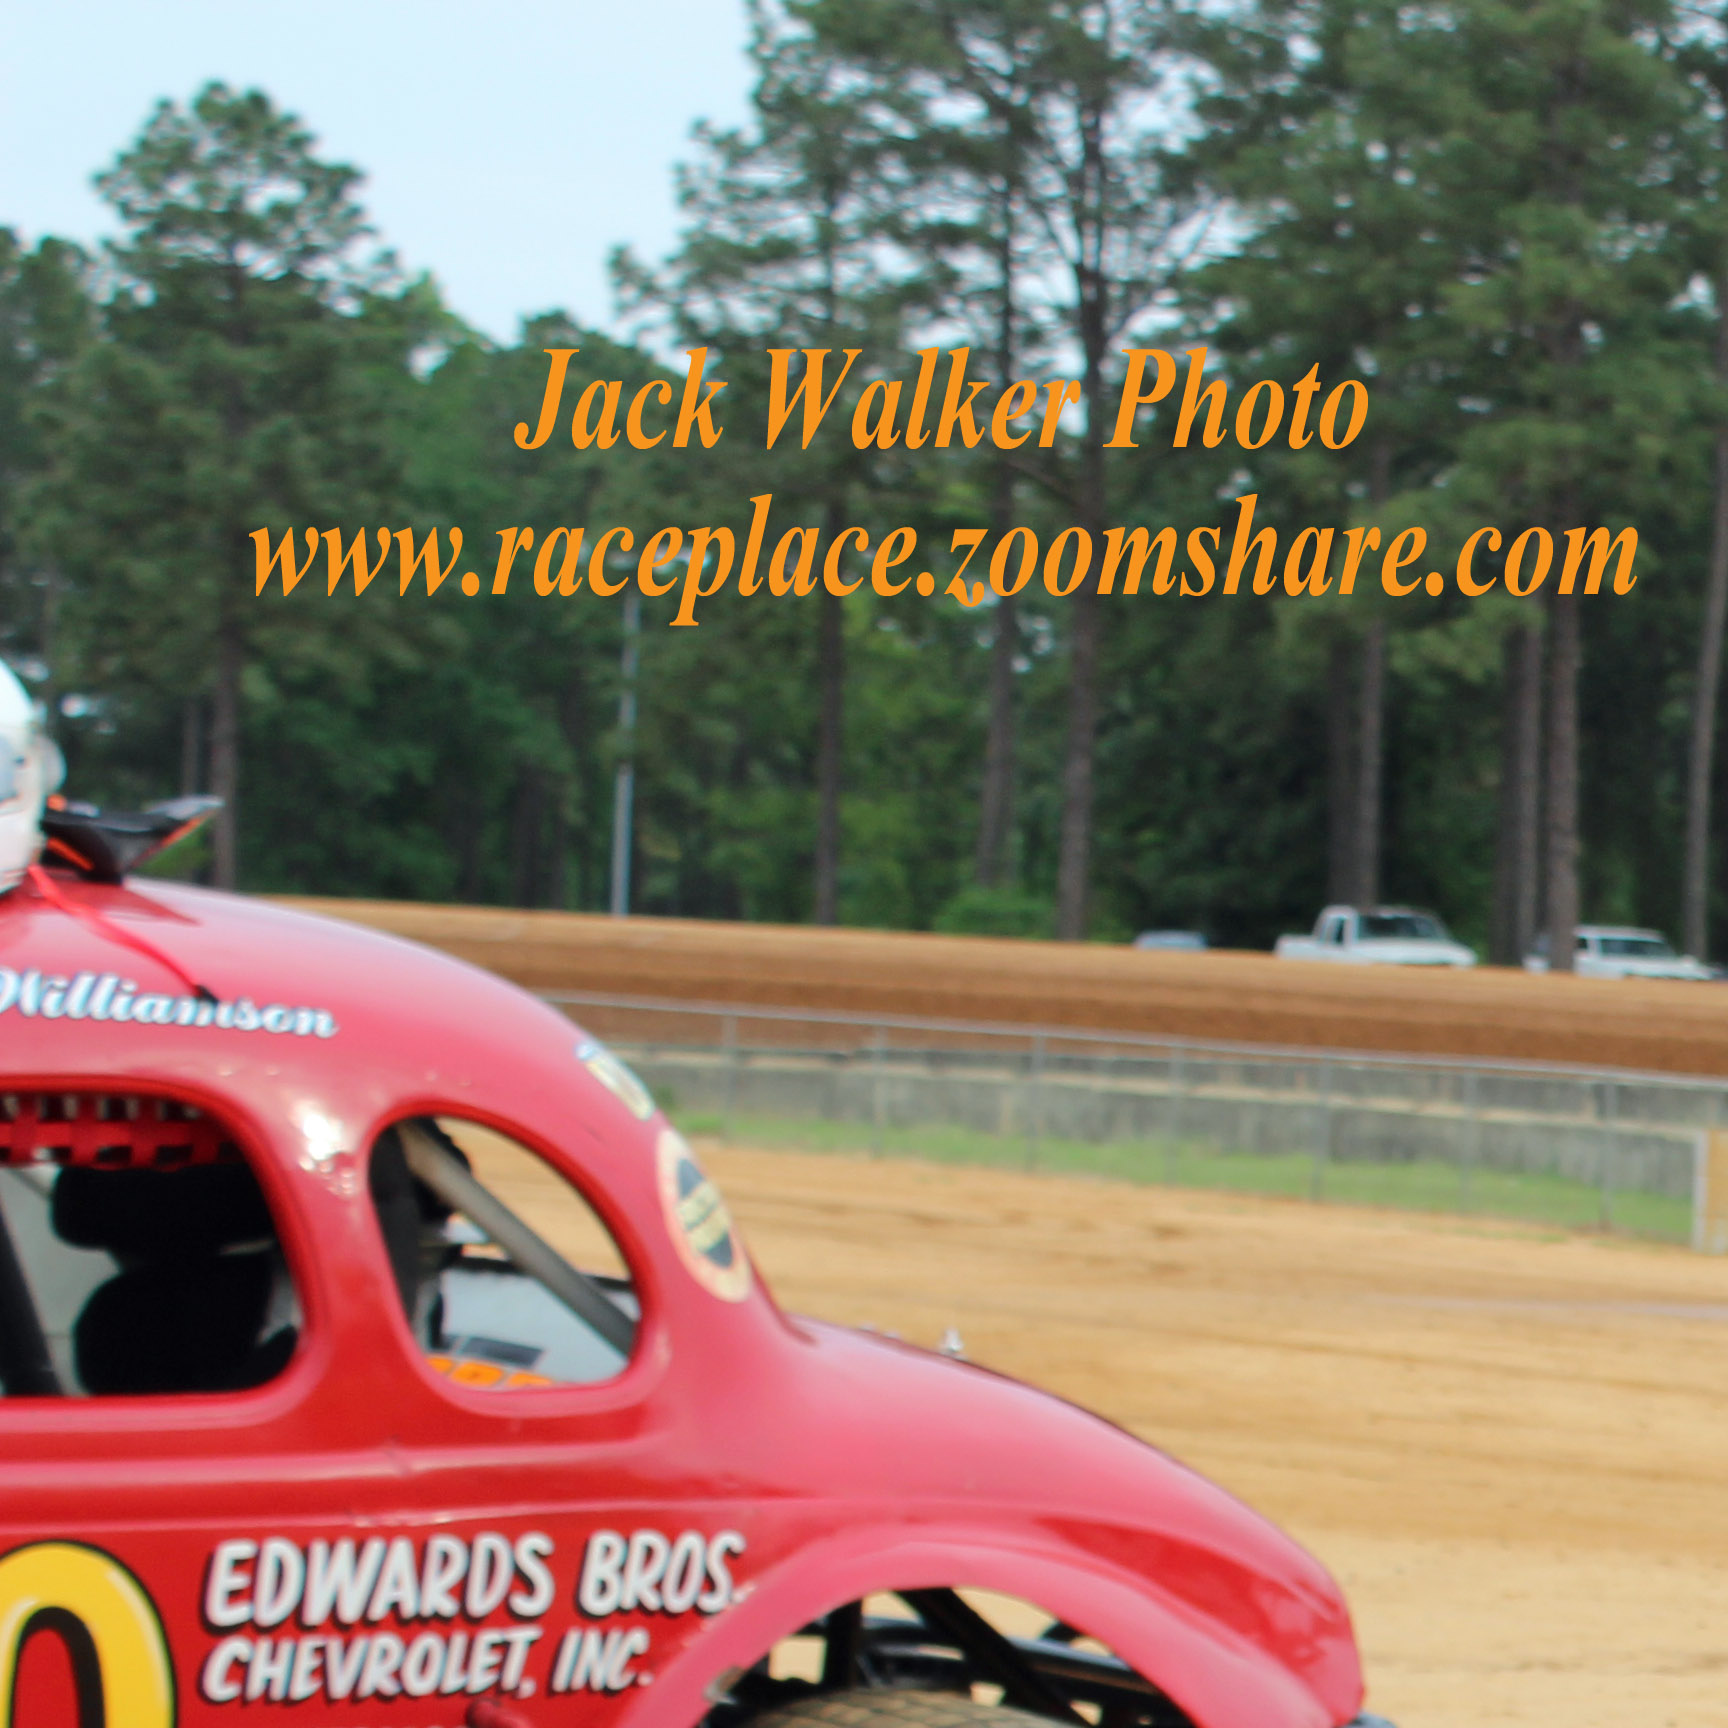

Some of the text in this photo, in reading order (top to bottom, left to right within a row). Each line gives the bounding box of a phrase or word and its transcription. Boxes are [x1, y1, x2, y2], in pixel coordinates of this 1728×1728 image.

[202, 1529, 750, 1630] EDWARDS BROS.
[200, 1626, 656, 1705] CHEVROLET, INC.
